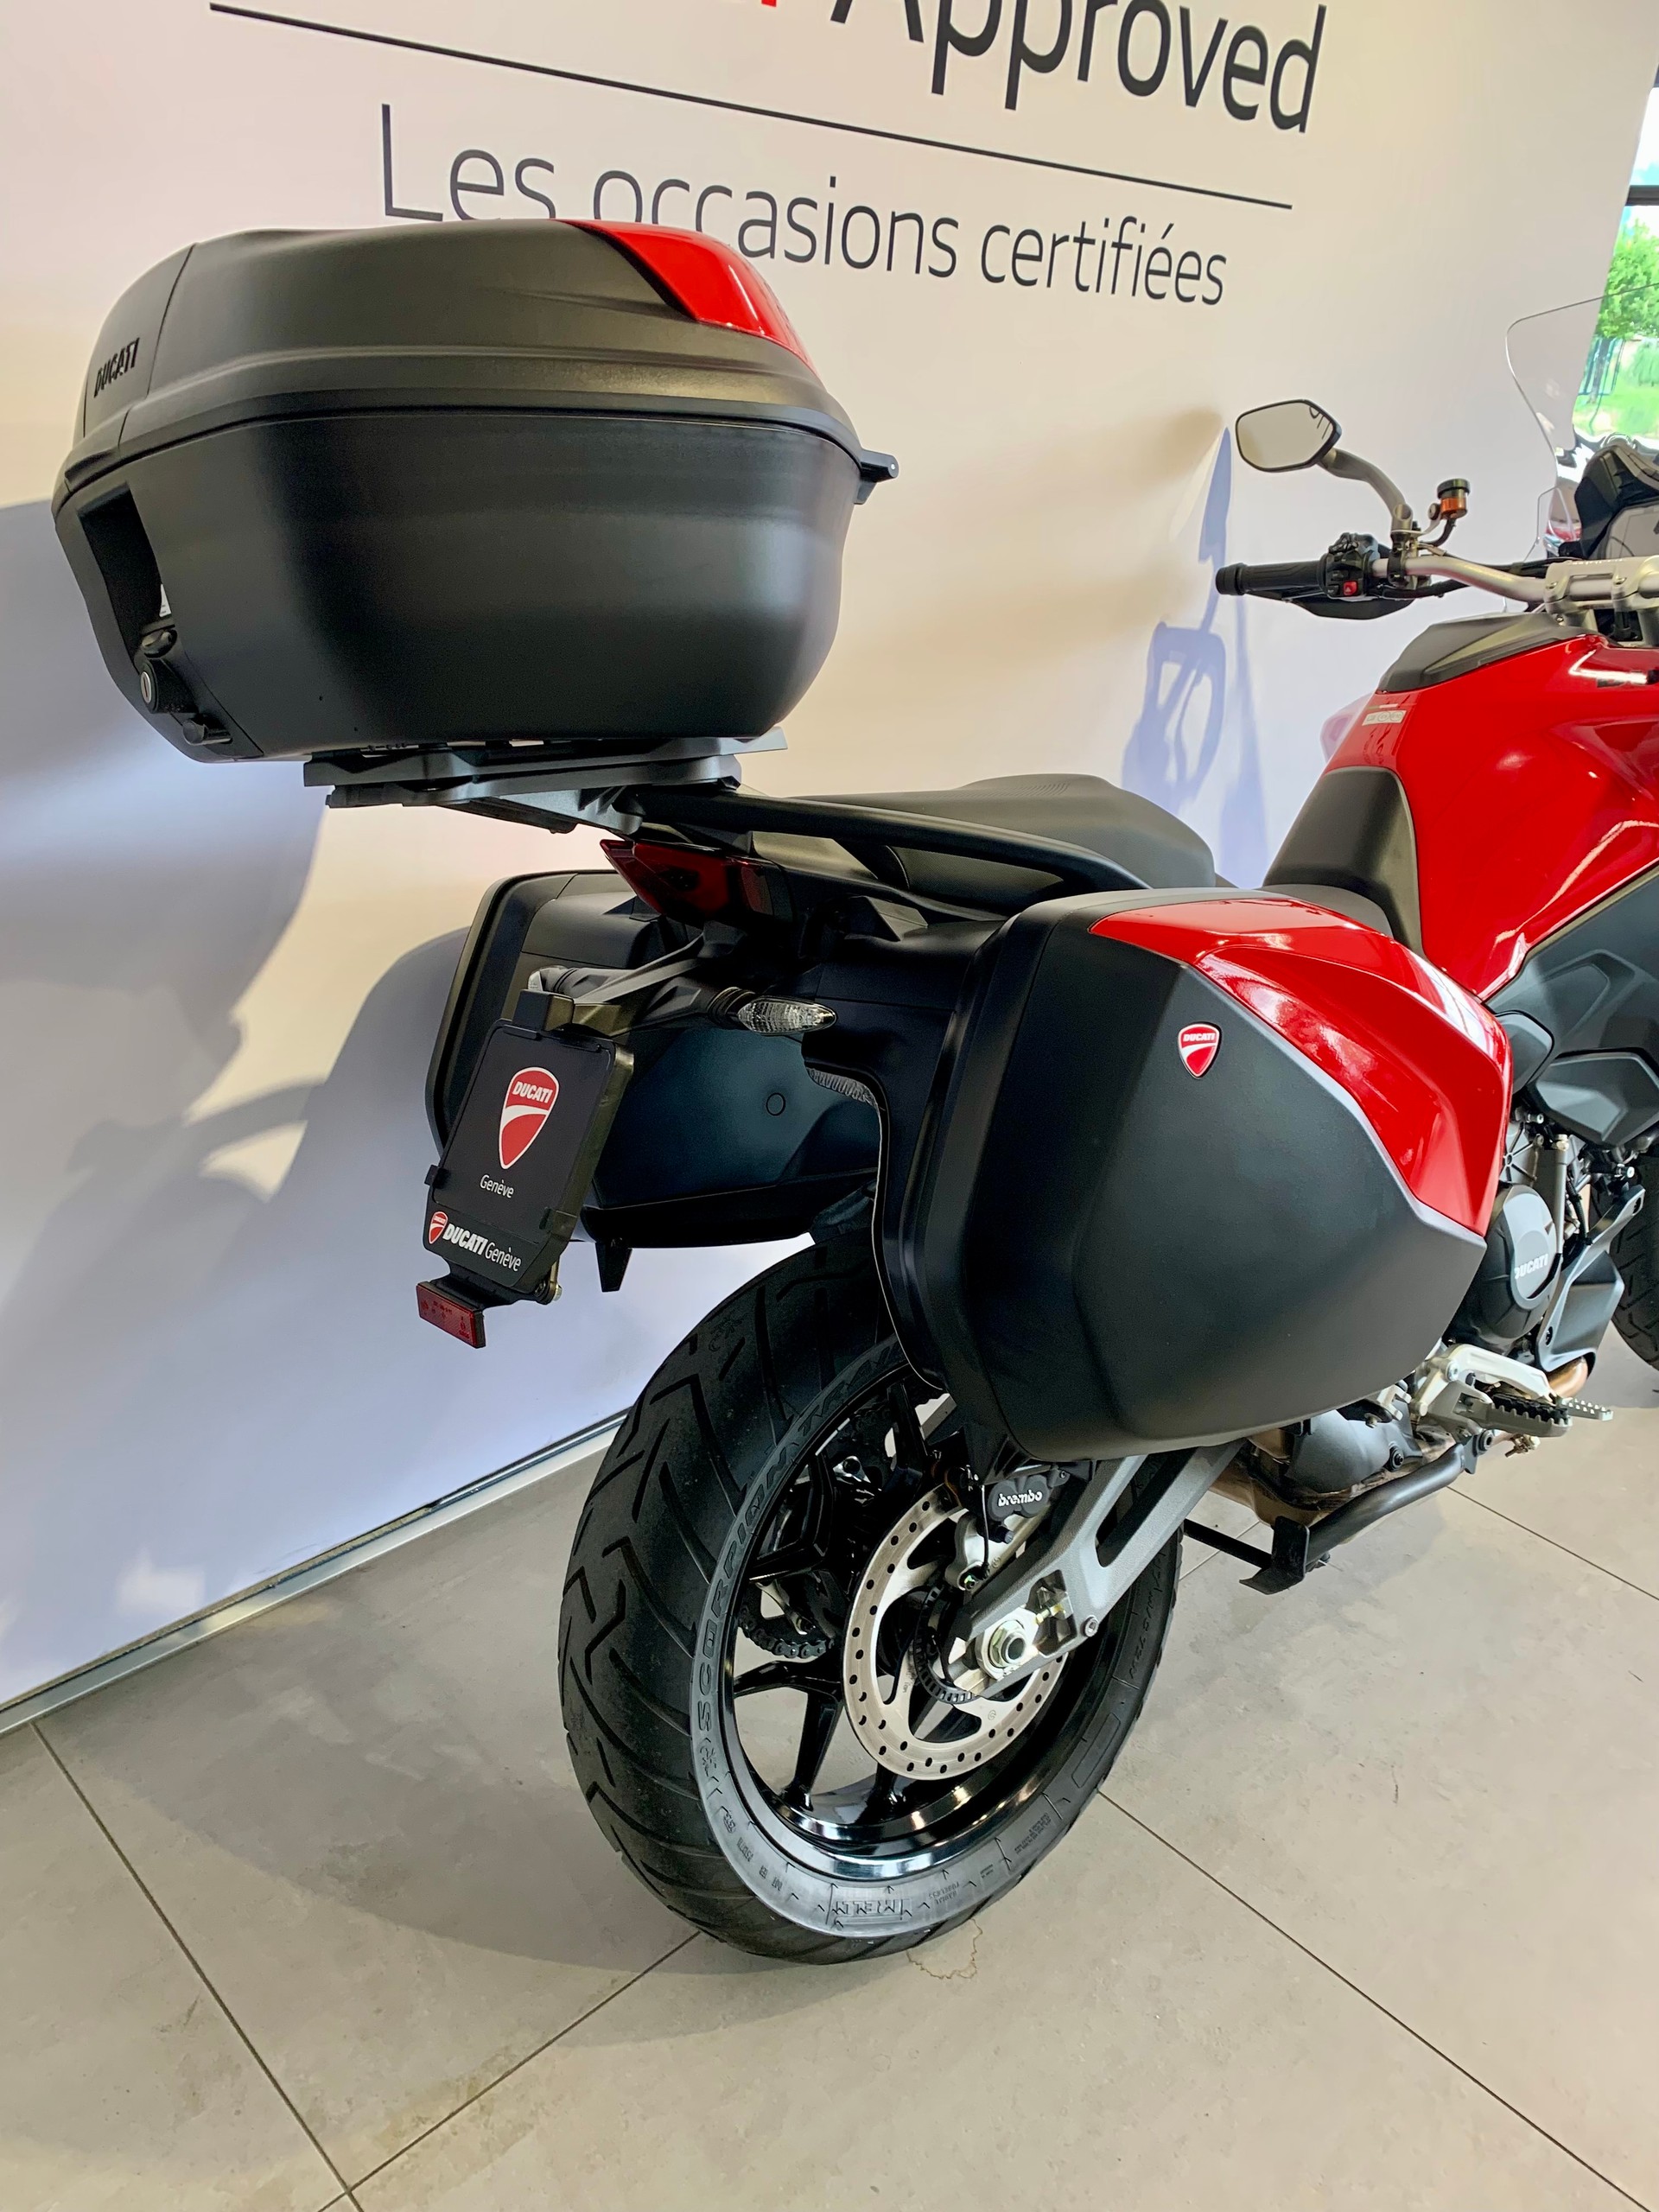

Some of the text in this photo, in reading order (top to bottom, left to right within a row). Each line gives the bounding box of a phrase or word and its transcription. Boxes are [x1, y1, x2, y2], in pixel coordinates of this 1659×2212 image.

[830, 0, 1327, 133] pproved
[381, 103, 1227, 306] Les occasions certifiées
[93, 337, 140, 398] DUCATI
[1183, 1033, 1216, 1042] DUCATI
[512, 1081, 553, 1103] DUCATI
[480, 1173, 514, 1198] Genève
[442, 1224, 522, 1272] DUCATI Genève
[997, 1489, 1043, 1507] brembo
